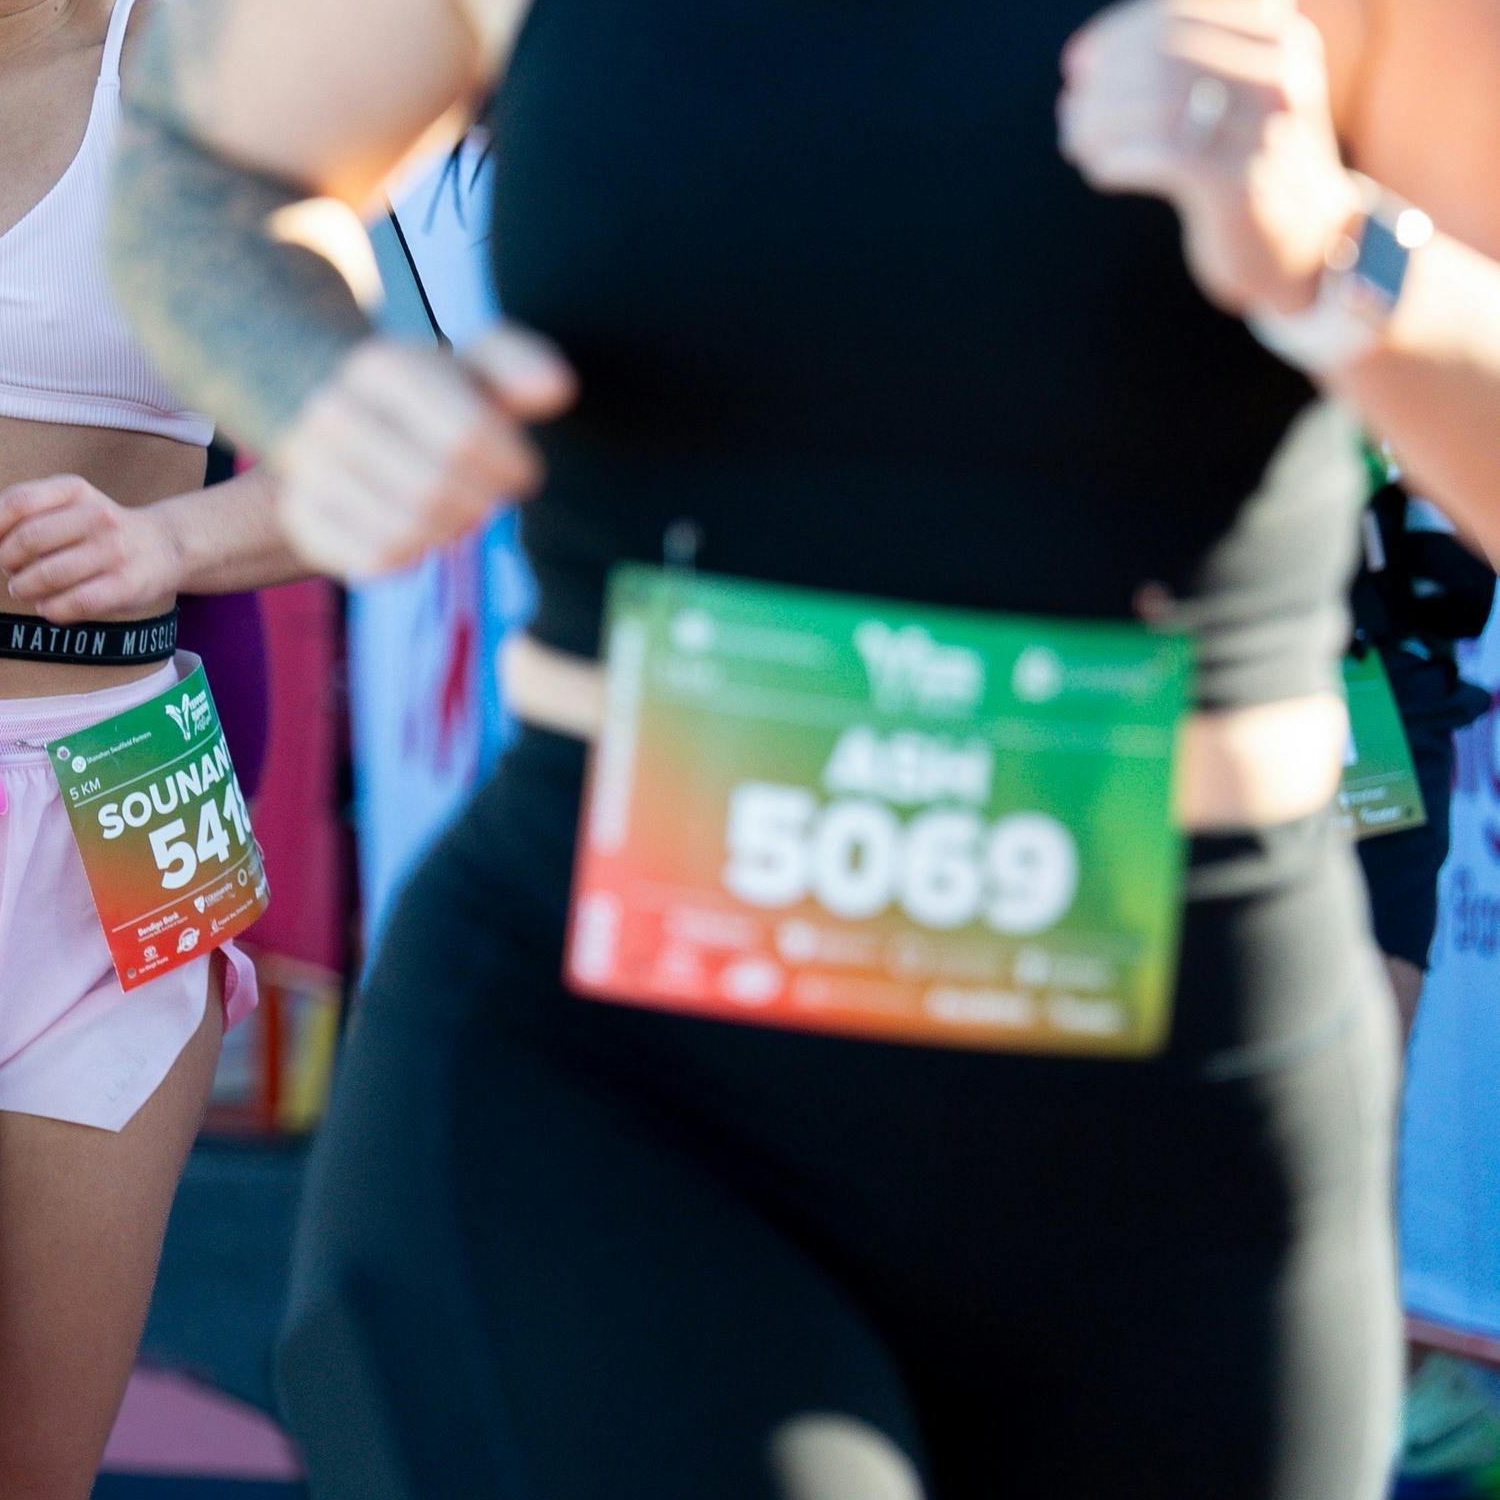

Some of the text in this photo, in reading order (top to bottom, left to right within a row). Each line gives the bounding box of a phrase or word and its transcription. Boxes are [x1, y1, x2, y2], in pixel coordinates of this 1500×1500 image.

[11, 622, 107, 656] NATION
[122, 621, 174, 656] MUSCLE
[69, 777, 101, 800] 5 KM
[722, 781, 1080, 936] 5069
[137, 920, 163, 938] Bendigo
